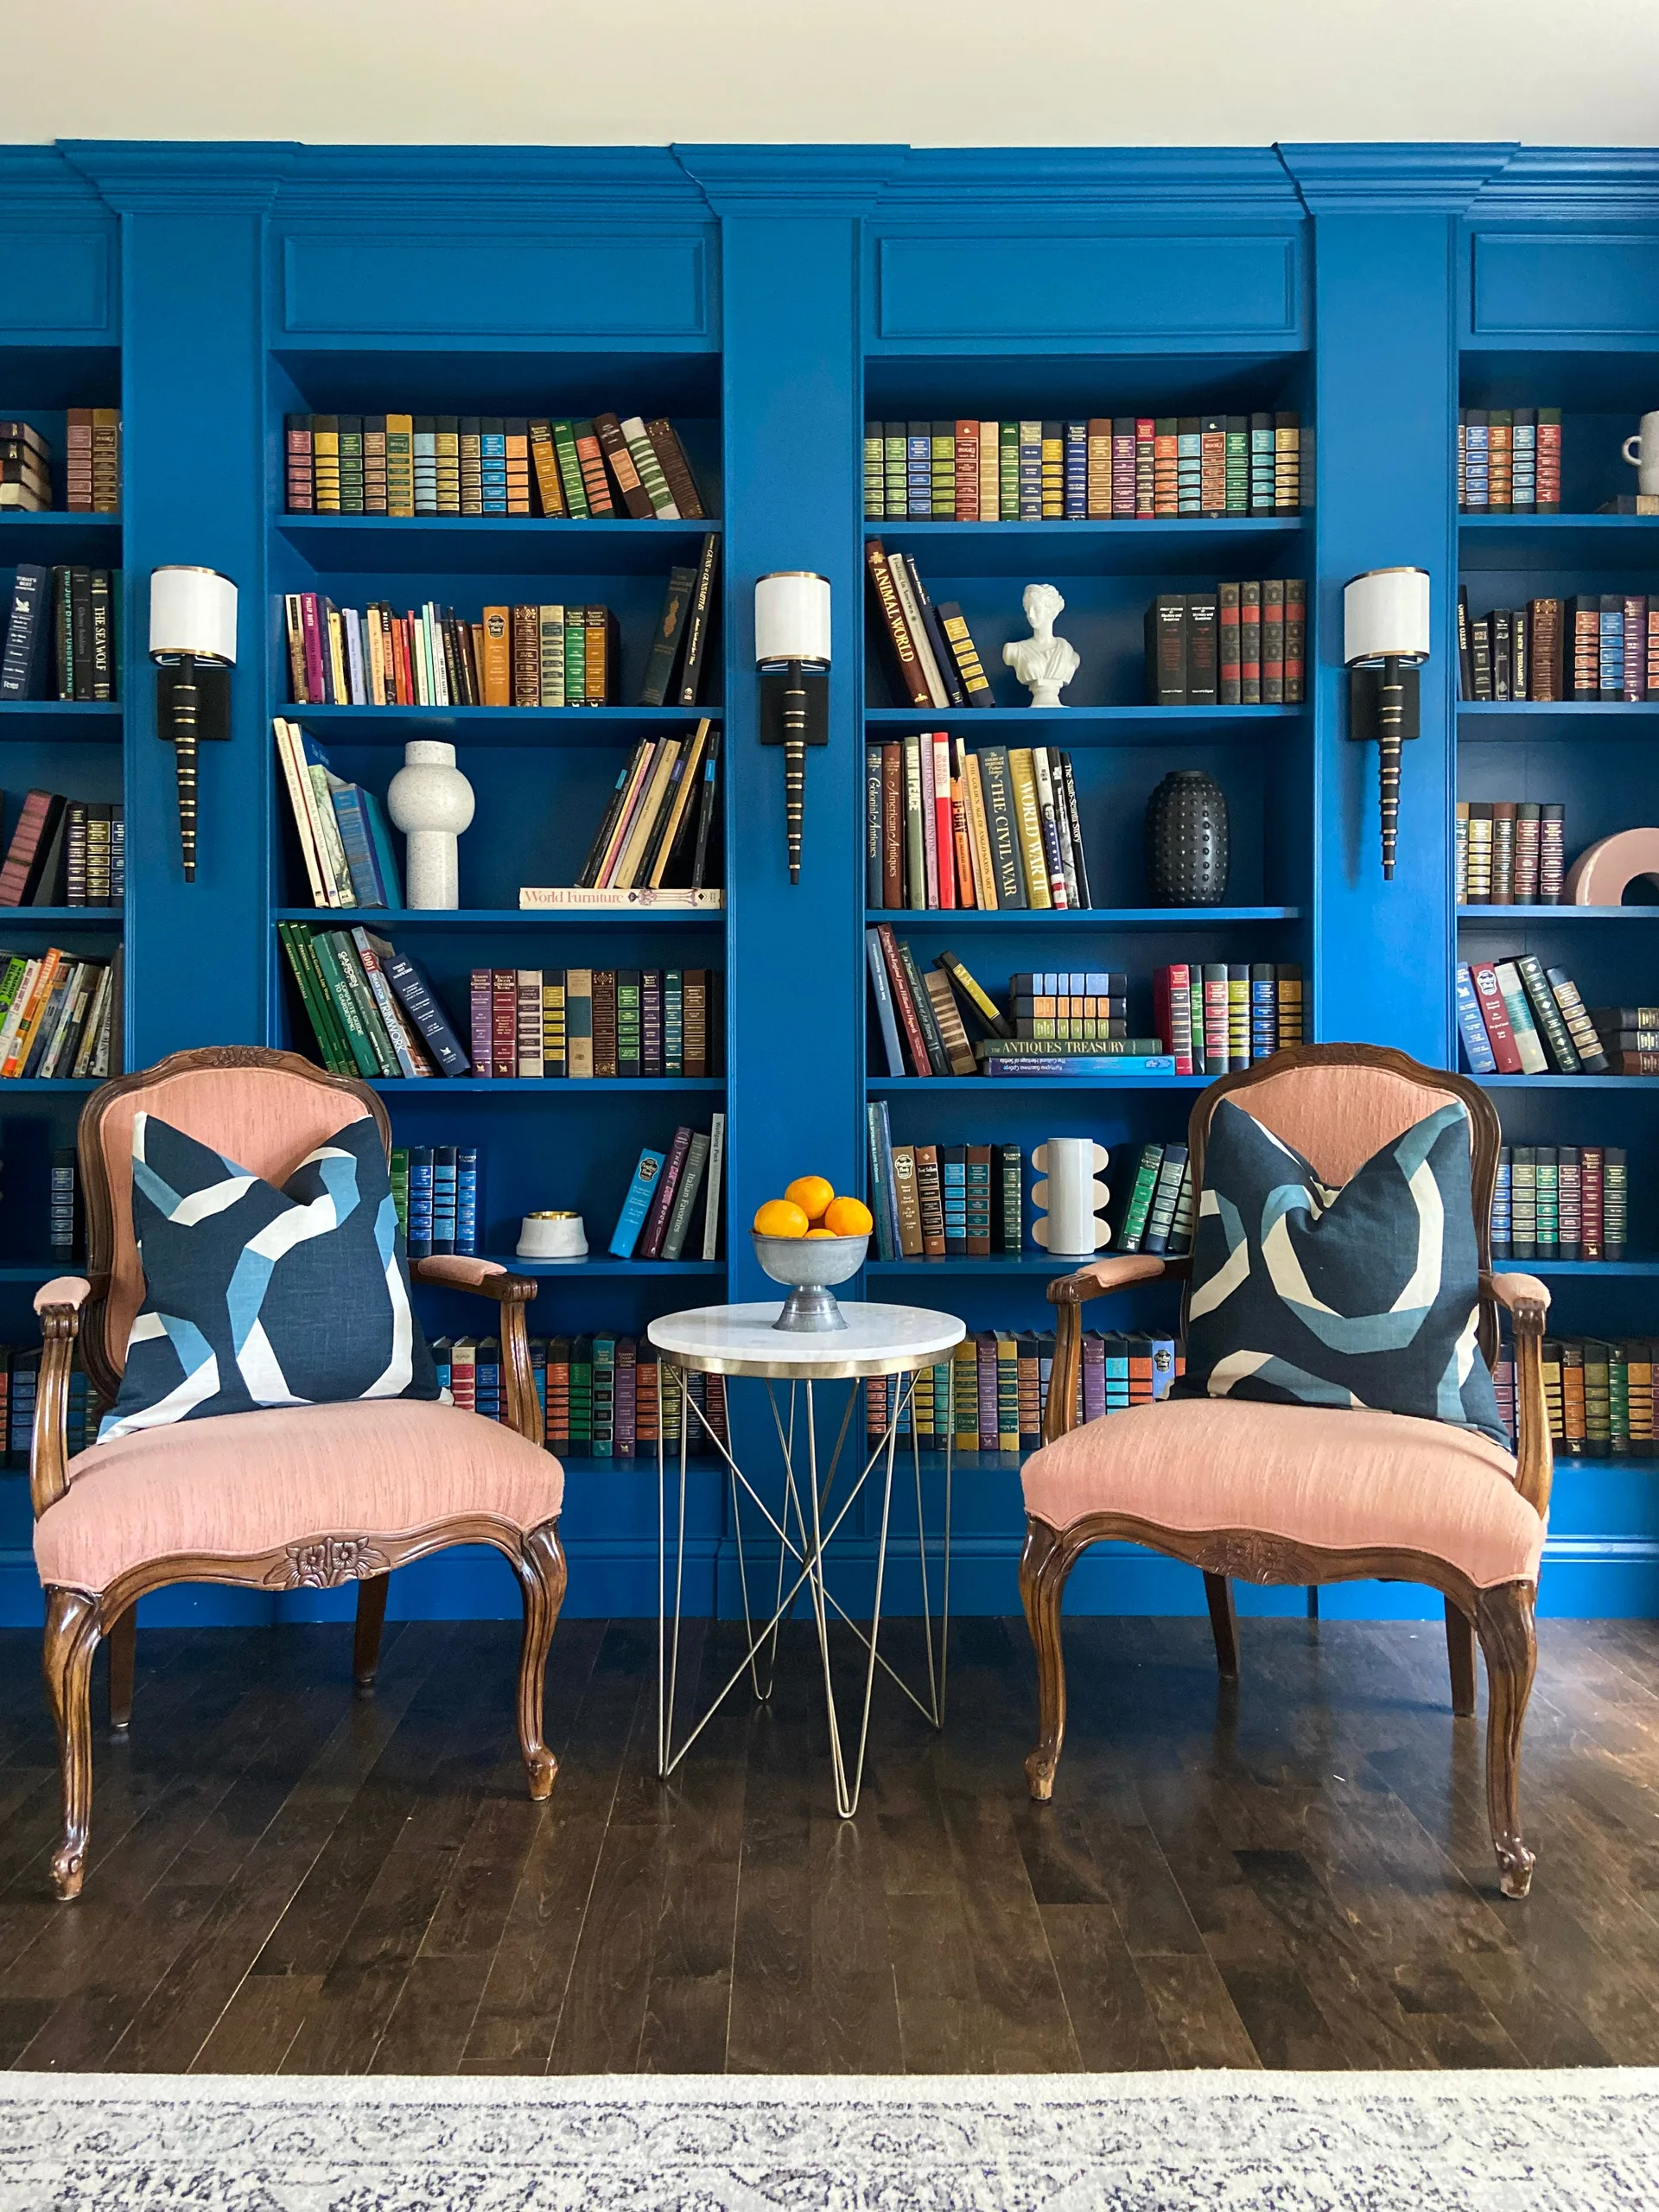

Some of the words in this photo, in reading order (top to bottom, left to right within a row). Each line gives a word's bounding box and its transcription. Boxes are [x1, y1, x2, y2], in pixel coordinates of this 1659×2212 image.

[892, 557, 903, 582] Fishing
[900, 579, 906, 589] in
[902, 588, 914, 614] America
[94, 607, 105, 626] THE
[874, 568, 899, 619] ANIMAL
[890, 618, 914, 663] WORLD
[95, 627, 105, 644] SEA
[96, 646, 106, 671] WOLF
[907, 745, 918, 767] WAR
[968, 762, 976, 776] THE
[907, 768, 918, 779] IN
[868, 776, 881, 814] Colonial
[907, 779, 920, 811] PEACE
[970, 777, 980, 804] GOLDEN
[989, 779, 1007, 813] THE
[1063, 763, 1073, 779] The
[1071, 823, 1081, 843] Story
[887, 779, 899, 831] American
[953, 799, 965, 834] D-DAY
[1018, 779, 1039, 837] WORLD
[868, 814, 881, 858] Antiques
[976, 820, 983, 829] OF
[978, 829, 990, 875] ANGLO-SAXON
[995, 819, 1013, 860] CIVIL
[887, 831, 899, 877] Antiques
[1026, 840, 1045, 875] WAR
[1000, 860, 1017, 897] WAR
[1032, 878, 1046, 892] II
[524, 890, 563, 903] World
[568, 890, 624, 903] Furniture
[341, 949, 358, 988] GARDEN
[361, 950, 376, 971] 1001
[881, 931, 894, 954] Drawing
[890, 957, 901, 978] England
[896, 976, 906, 990] from
[334, 982, 341, 993] TO
[371, 971, 380, 988] IDEAS
[376, 988, 385, 1000] FOR
[901, 952, 909, 963] An
[905, 962, 916, 987] Illustrated
[912, 984, 924, 1008] Handbook
[923, 1021, 933, 1041] History
[337, 992, 355, 1032] GARDENING
[339, 980, 356, 1015] COMPLETE
[352, 1014, 364, 1037] GUIDE
[379, 1000, 404, 1053] TRIMWORK
[1002, 1042, 1061, 1053] ANTIQUES
[1065, 1041, 1125, 1053] TREASURY
[712, 1122, 721, 1148] Wolfgang
[667, 1166, 678, 1186] CAN'T
[681, 1173, 696, 1198] Italian
[662, 1185, 674, 1205] COOK
[658, 1205, 668, 1224] BOOK
[673, 1197, 690, 1233] Favorites
